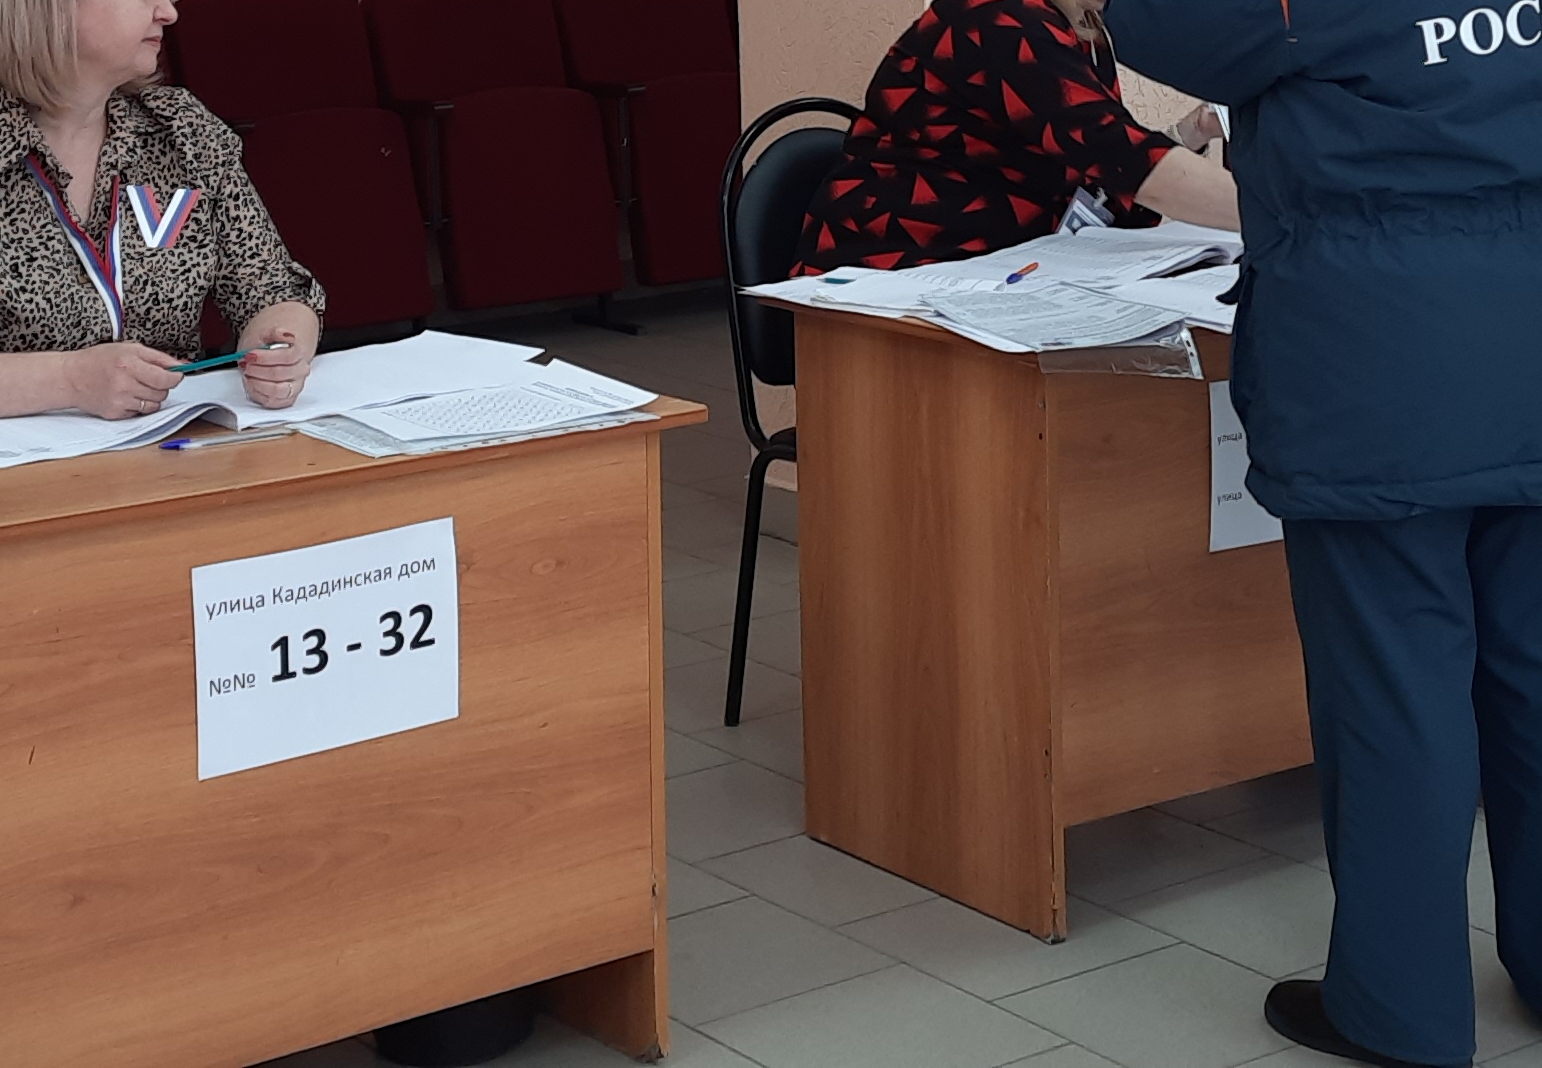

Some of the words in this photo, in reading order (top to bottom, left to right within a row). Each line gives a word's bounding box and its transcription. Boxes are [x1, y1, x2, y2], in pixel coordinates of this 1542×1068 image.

[205, 594, 265, 620] улица
[272, 565, 392, 605] Кададинская
[397, 557, 436, 580] дом
[209, 672, 256, 697] №№
[270, 628, 329, 683] 13
[346, 642, 362, 652] -
[378, 604, 436, 657] 32
